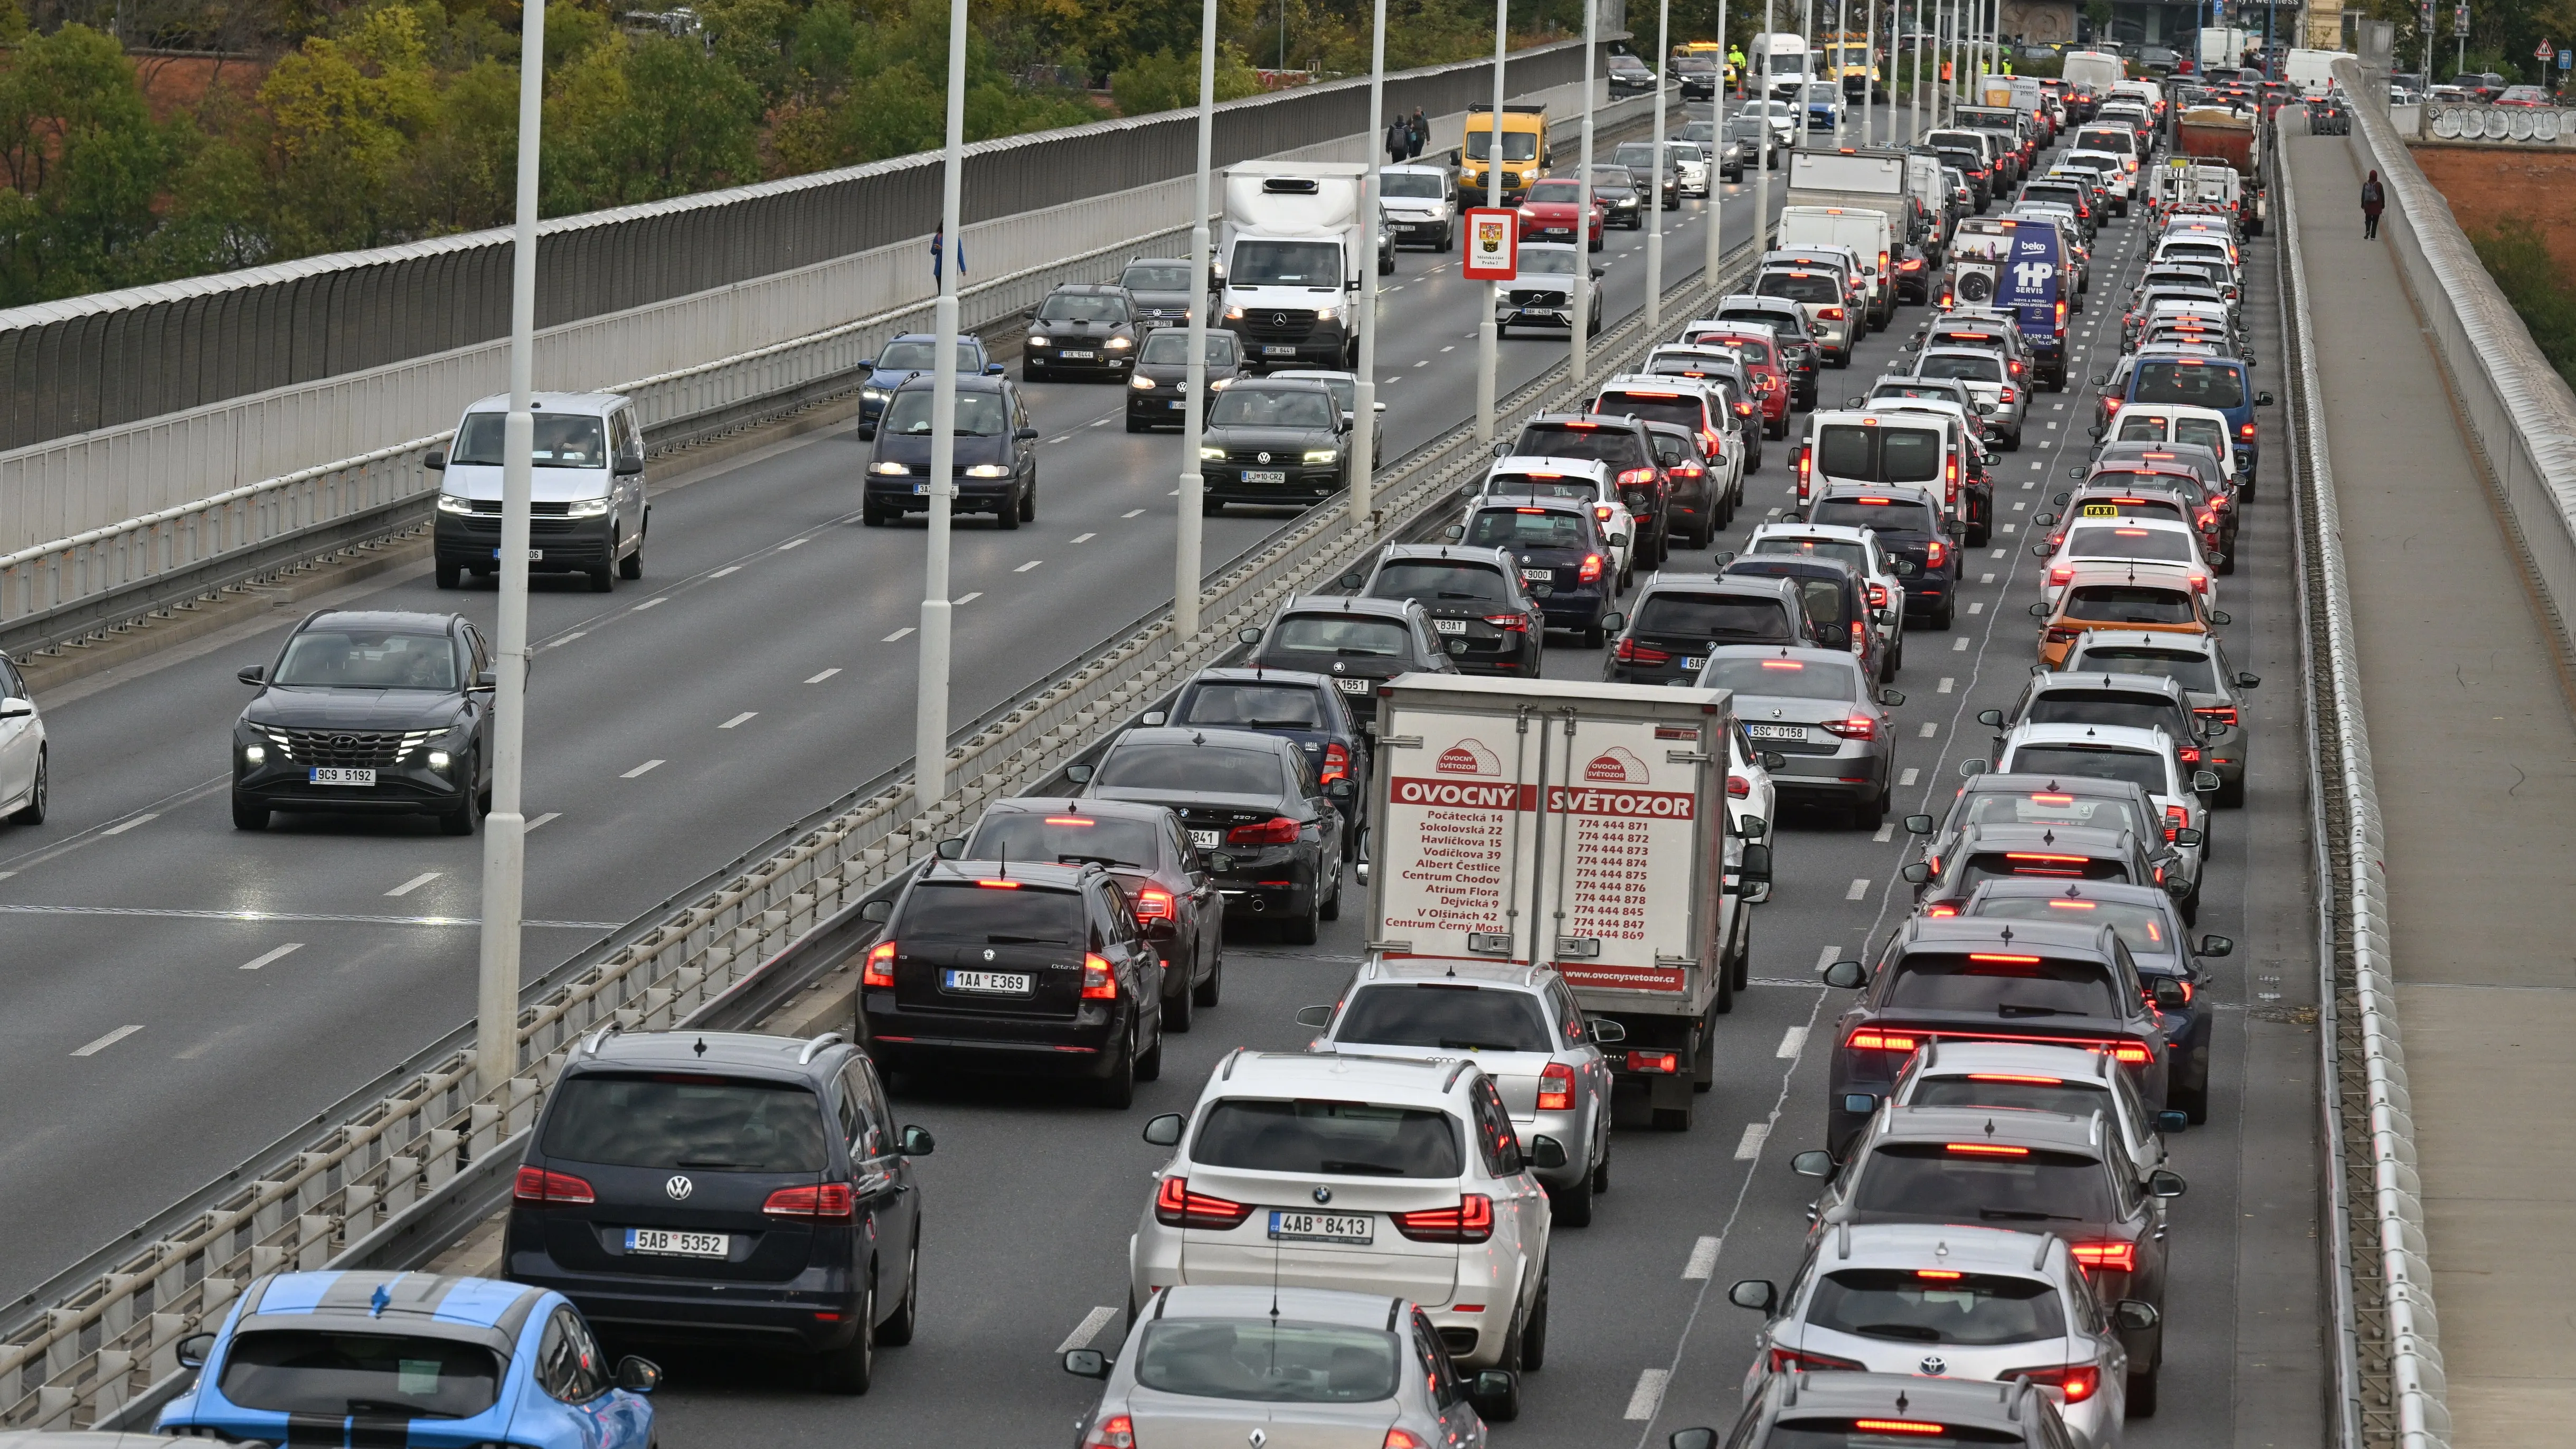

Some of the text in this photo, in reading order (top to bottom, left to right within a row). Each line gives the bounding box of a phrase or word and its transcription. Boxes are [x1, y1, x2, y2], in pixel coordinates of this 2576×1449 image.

[2022, 241, 2045, 251] beko
[1528, 570, 1548, 579] 9000
[1440, 622, 1461, 631] 83AT
[1342, 679, 1364, 690] 1551
[1753, 727, 1803, 738] 5SC 0158
[318, 770, 371, 781] 9C9 5192
[1401, 783, 1690, 816] OVOCNÝ SVĚTOZOR
[1428, 811, 1503, 823] Počátecká 14
[1420, 822, 1502, 835] Sokolovská 22
[1421, 835, 1484, 846] Havlíčkova
[1602, 833, 1624, 841] 444
[1628, 834, 1649, 843] 872
[1423, 847, 1501, 860] Vodičkova 39
[1578, 844, 1598, 852] 774
[1627, 846, 1648, 855] 873
[1416, 859, 1500, 872] Albert Čestlice
[1577, 856, 1647, 867] 774 444 874
[1402, 871, 1500, 884] Centrum Chodov
[1577, 869, 1647, 880] 774 444 875
[1425, 885, 1498, 897] Atrium Flora
[1575, 881, 1646, 892] 774 444 876
[1441, 896, 1488, 908] Dejvická
[1575, 893, 1646, 904] 774 444 878
[1429, 909, 1479, 920] Olšinách
[1483, 912, 1497, 921] 42
[1574, 905, 1594, 914] 774
[1622, 908, 1643, 916] 845
[1385, 918, 1504, 933] Centrum Černý Most
[1623, 920, 1644, 929] 847
[1572, 928, 1644, 940] 774 444 869
[958, 972, 1023, 990] 1AA E369
[1565, 971, 1675, 983] www.ovocnysvetozor.cz
[1282, 1214, 1365, 1236] 4AB 8413
[638, 1230, 721, 1253] 5AB 5352
